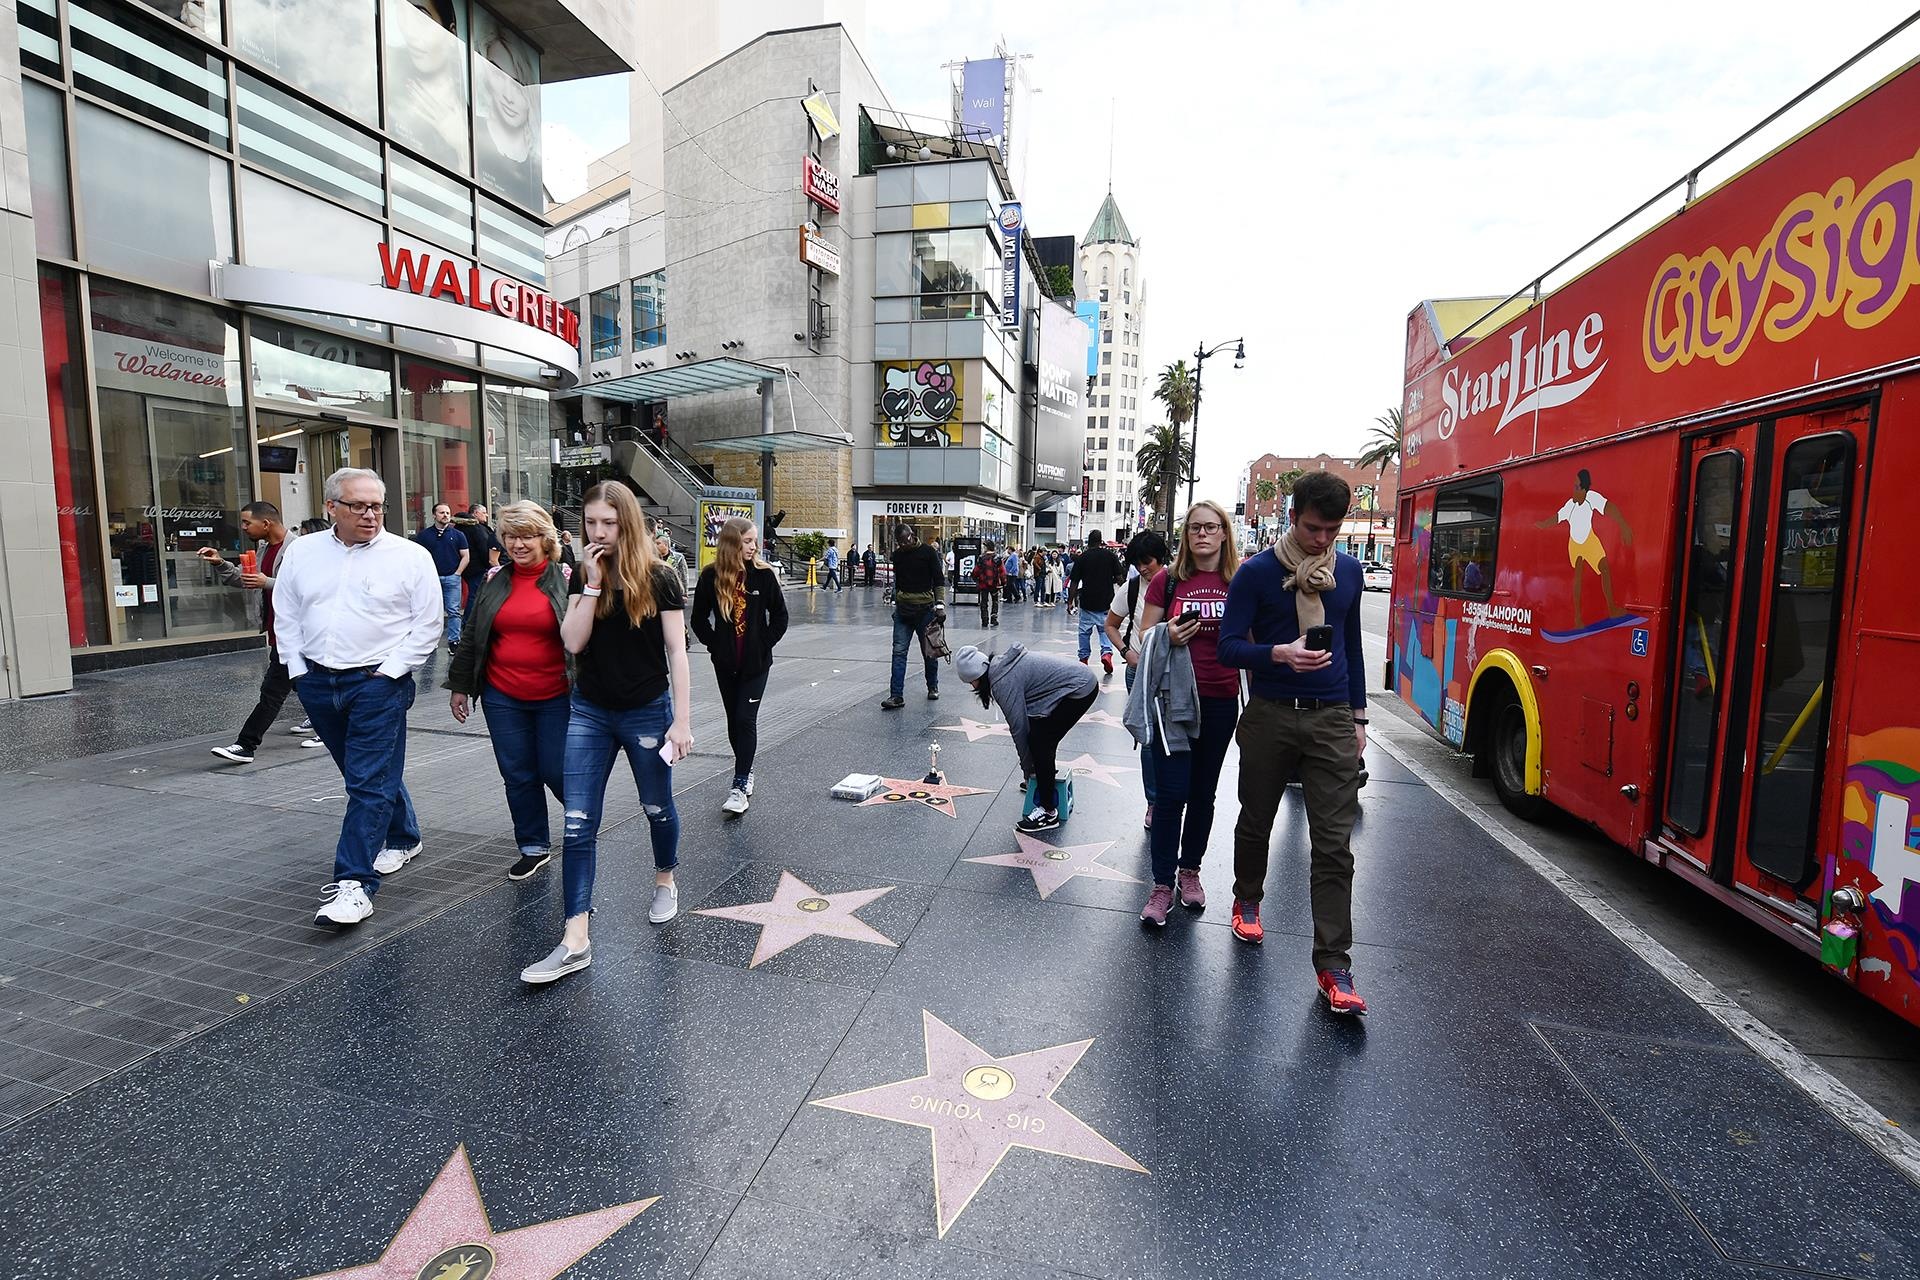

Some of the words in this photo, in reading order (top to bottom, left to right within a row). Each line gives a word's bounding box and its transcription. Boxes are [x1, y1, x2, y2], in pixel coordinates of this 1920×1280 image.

[972, 97, 995, 109] Wall
[811, 173, 840, 200] WABO
[812, 163, 840, 189] CABO
[1004, 235, 1016, 258] PLAY
[1643, 148, 1920, 373] CitySig
[1003, 269, 1016, 297] DRINK
[1003, 308, 1015, 324] EAT
[145, 345, 204, 366] Welcome
[207, 357, 219, 369] to
[114, 352, 226, 388] Walgreen
[1040, 377, 1078, 408] MATTER
[142, 505, 223, 522] Walgreens
[886, 502, 929, 514] FOREVER
[932, 503, 943, 514] 21
[909, 1095, 983, 1122] YOUNG
[1006, 1113, 1046, 1133] GIG
